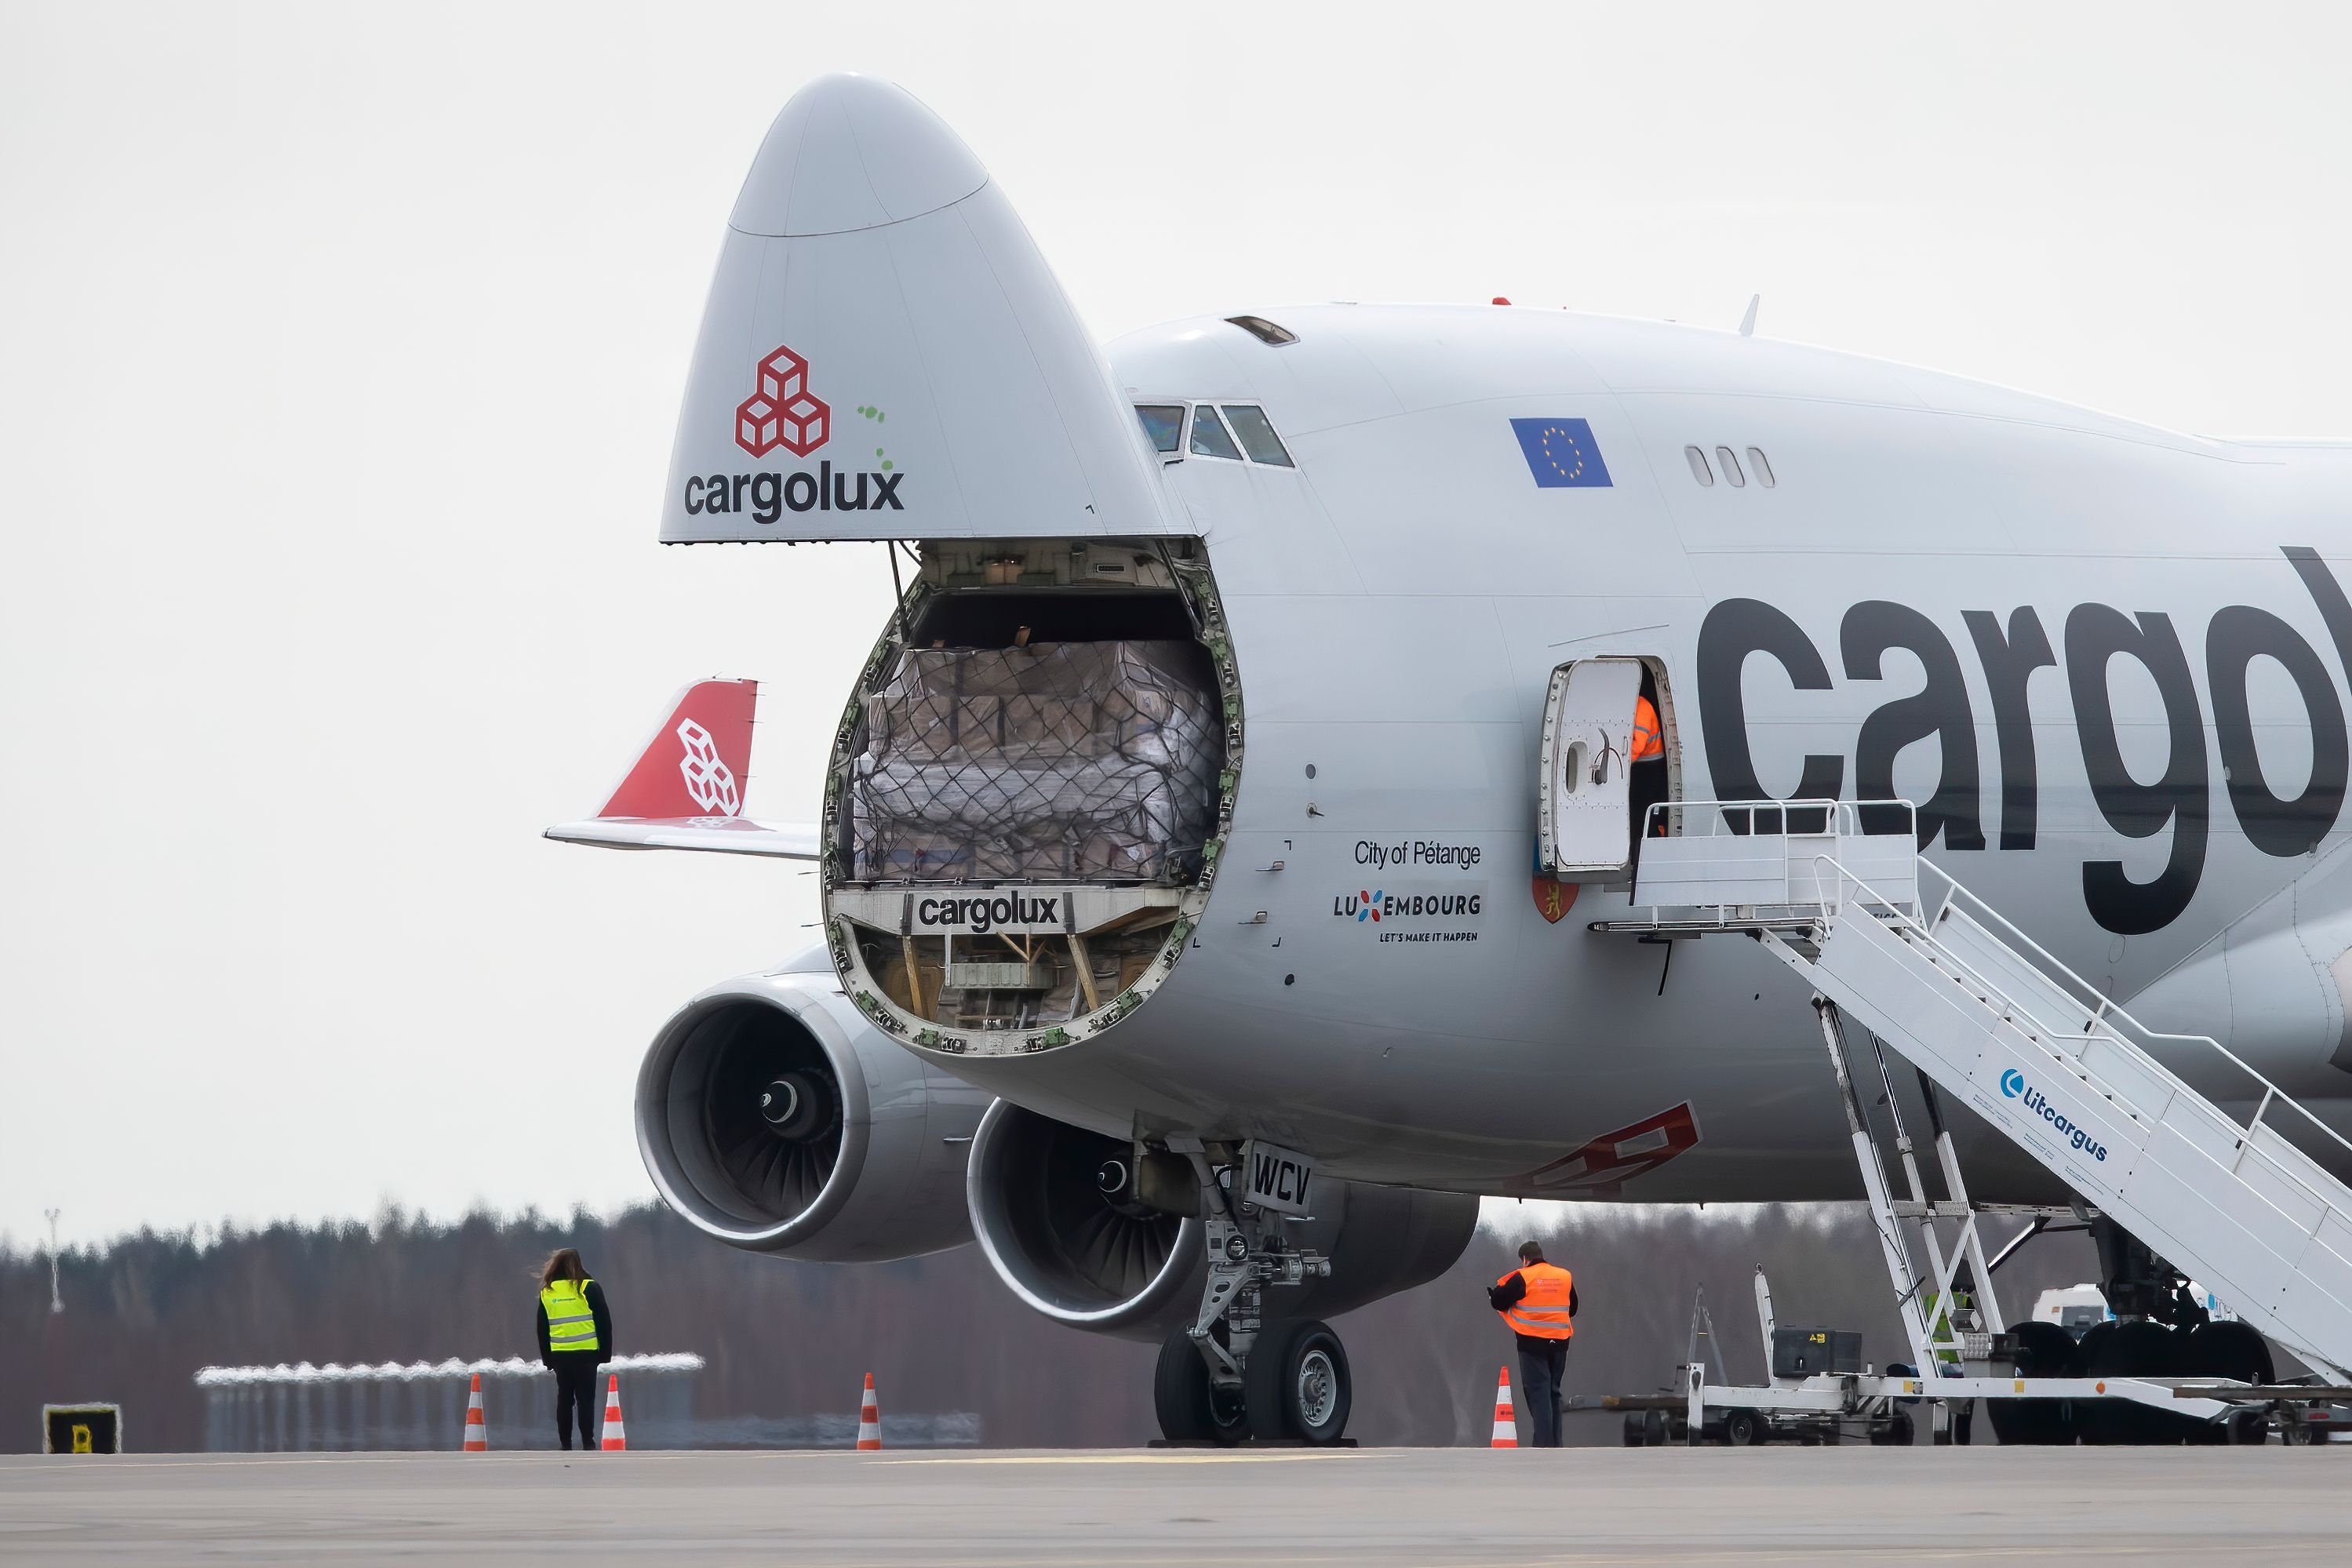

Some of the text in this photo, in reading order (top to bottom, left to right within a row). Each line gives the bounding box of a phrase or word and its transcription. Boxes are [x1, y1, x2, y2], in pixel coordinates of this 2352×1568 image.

[684, 460, 905, 524] cargolux
[1355, 840, 1480, 871] City of Pétange
[919, 890, 1059, 933] cargolux
[1379, 932, 1478, 943] LET'S MAKE IT HAPPEN
[1254, 1153, 1311, 1206] WCV
